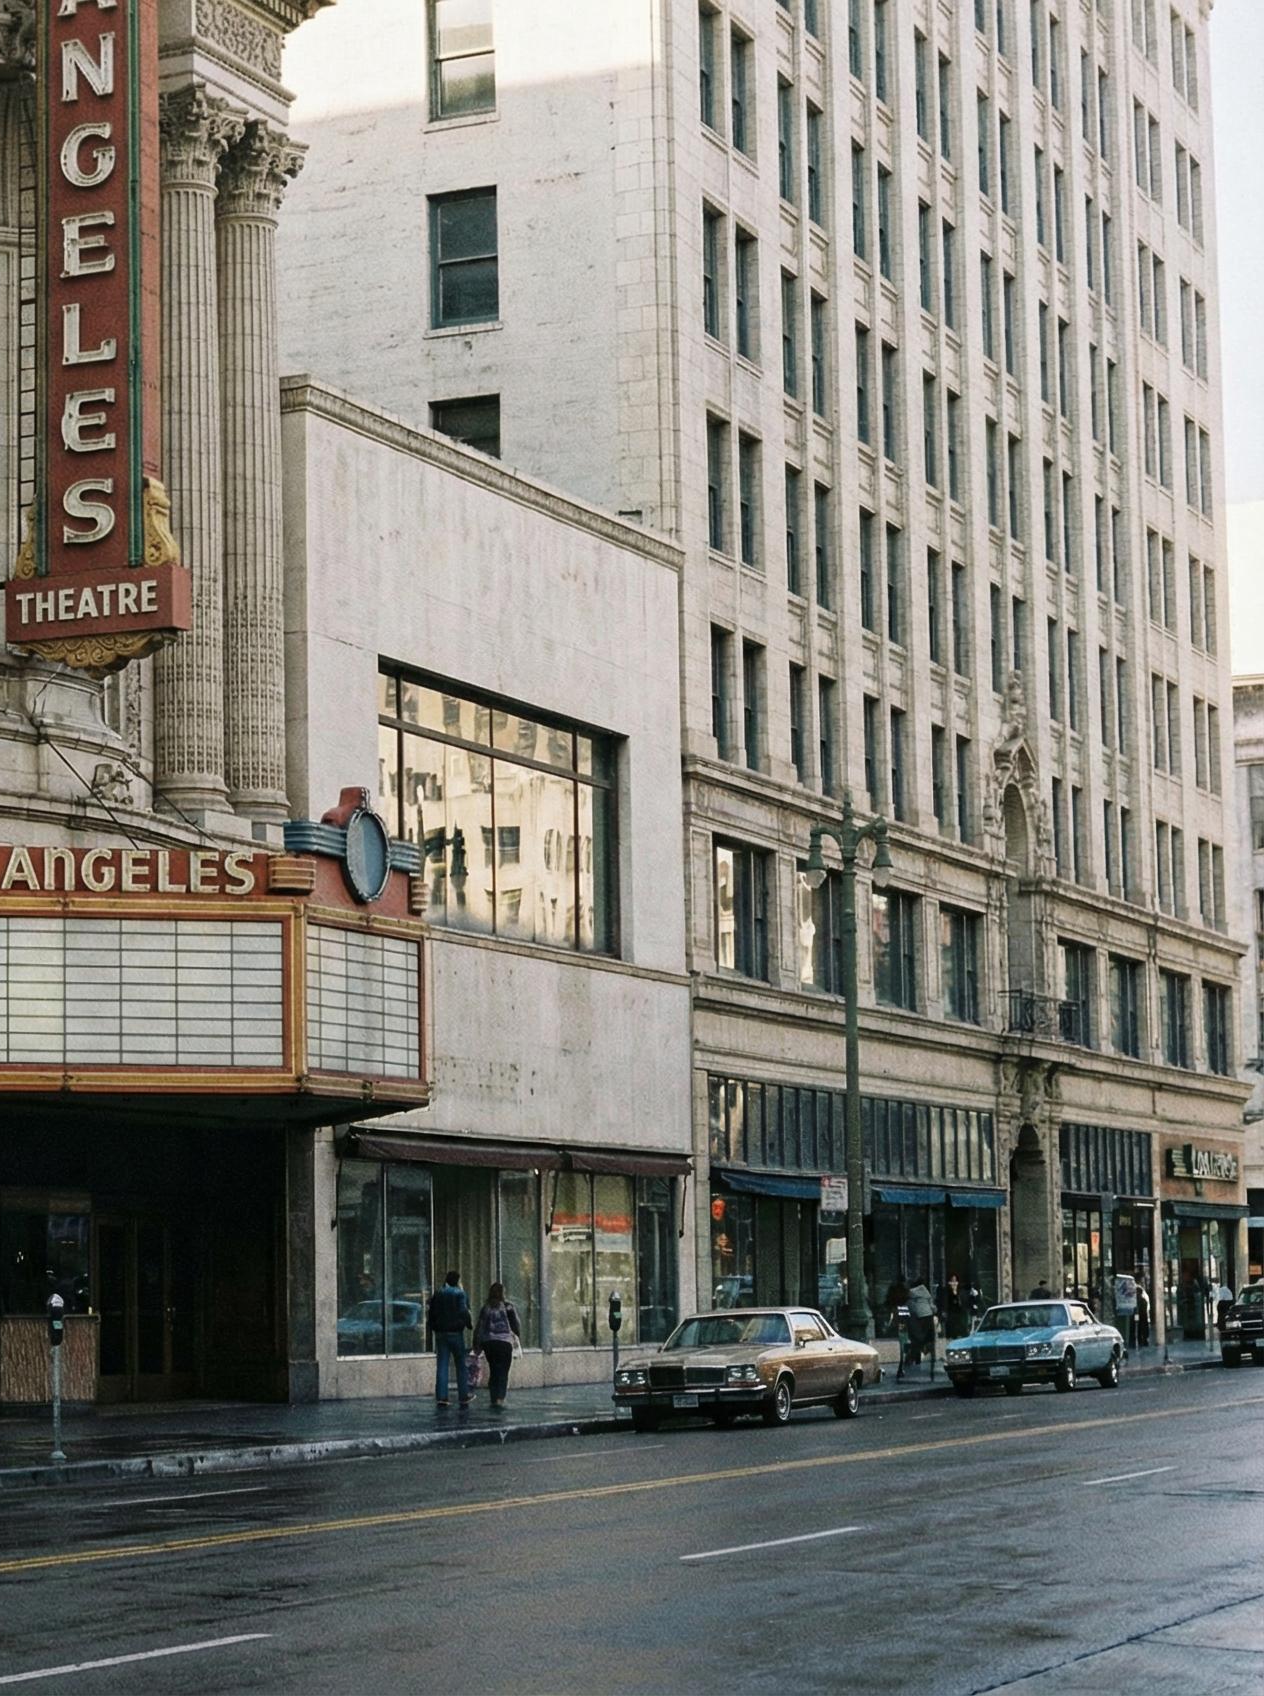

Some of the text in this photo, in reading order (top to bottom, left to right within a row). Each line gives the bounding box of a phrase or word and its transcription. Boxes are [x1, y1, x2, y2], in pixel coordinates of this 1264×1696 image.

[57, 0, 117, 543] NGELES
[16, 580, 158, 625] THEATRE
[1, 846, 255, 894] ANGELES
